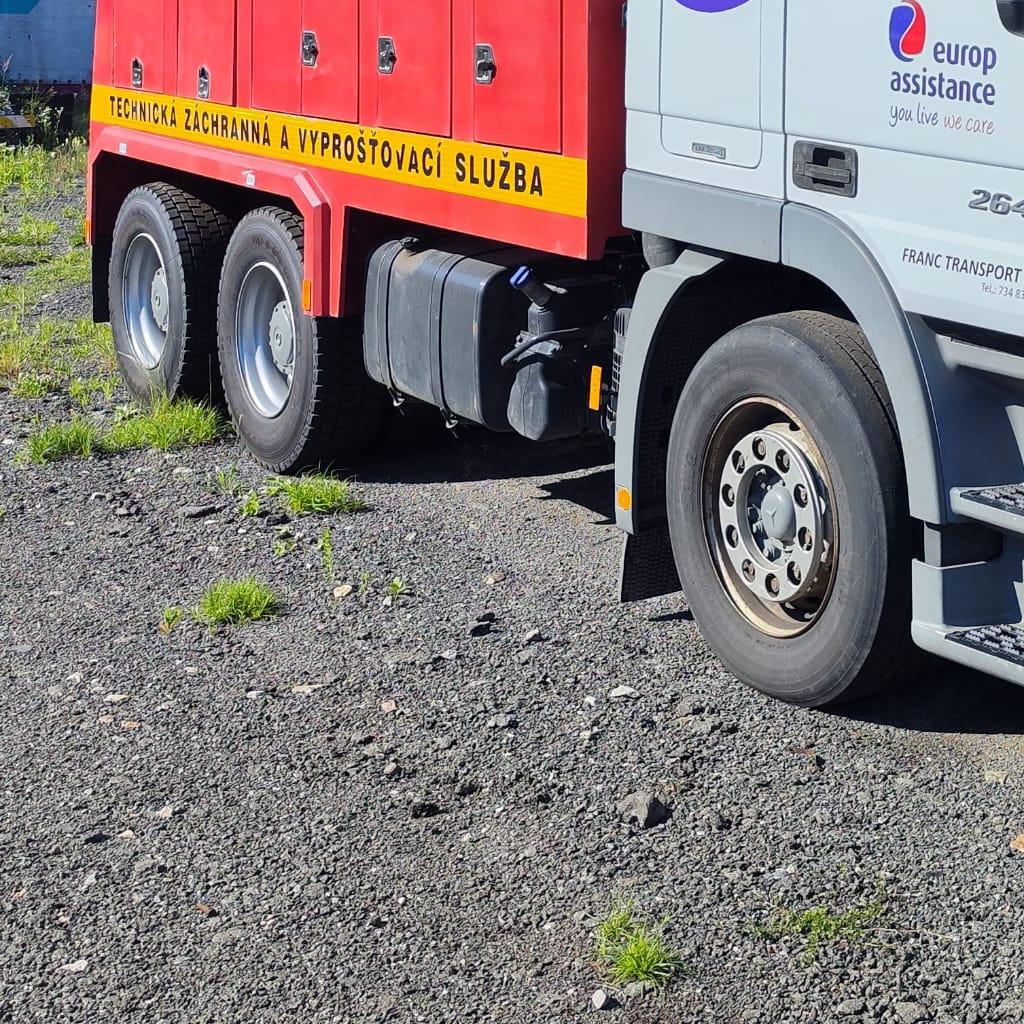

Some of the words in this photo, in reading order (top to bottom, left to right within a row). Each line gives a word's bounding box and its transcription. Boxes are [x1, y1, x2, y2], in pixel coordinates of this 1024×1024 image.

[933, 41, 997, 76] europ
[890, 67, 996, 106] assistance
[888, 104, 914, 128] you
[916, 102, 939, 126] live
[943, 114, 962, 130] we
[965, 118, 995, 135] care
[109, 95, 178, 128] TECHNICKÁ
[184, 103, 271, 147] ZÁCHRANNÁ
[280, 124, 289, 150] A
[298, 128, 442, 178] VYPROŠŤOVACÍ
[455, 151, 543, 197] SLUŽBA
[902, 247, 942, 269] FRANC
[945, 255, 1022, 283] TRANSPORT
[998, 285, 1014, 297] 734
